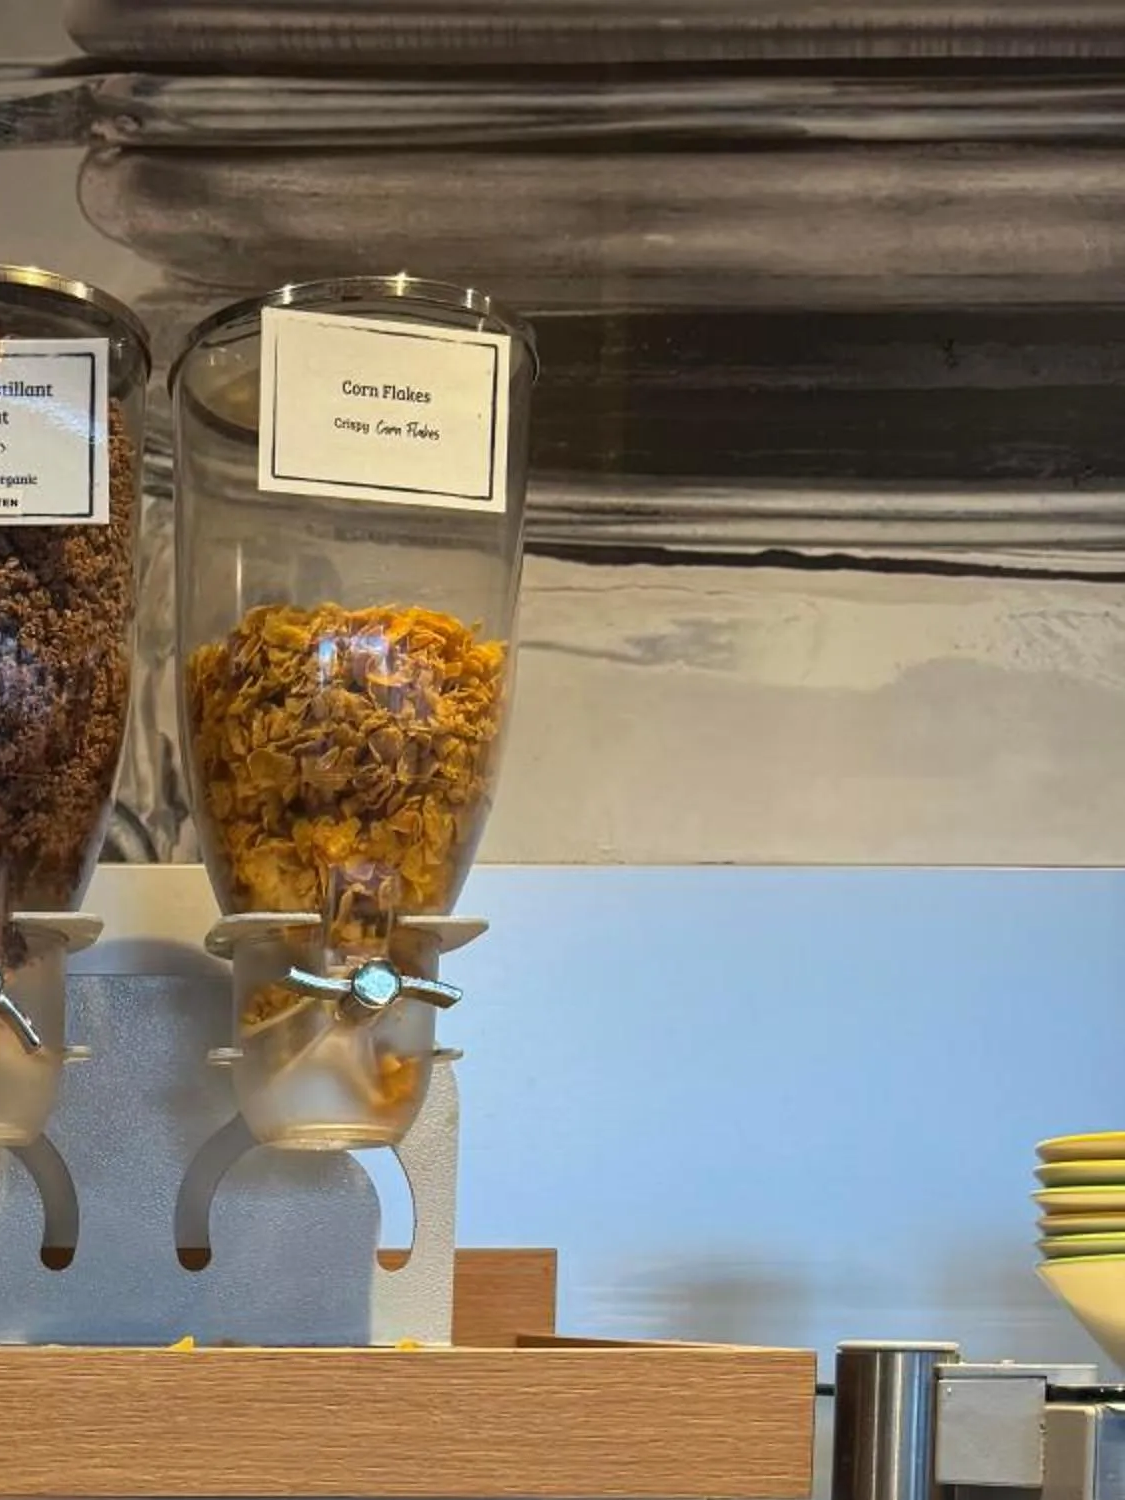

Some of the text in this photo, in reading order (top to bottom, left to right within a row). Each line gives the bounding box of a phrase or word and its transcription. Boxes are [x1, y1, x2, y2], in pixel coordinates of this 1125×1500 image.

[342, 380, 432, 403] Corn Flakes
[334, 417, 440, 440] Crispy Corn Flakes
